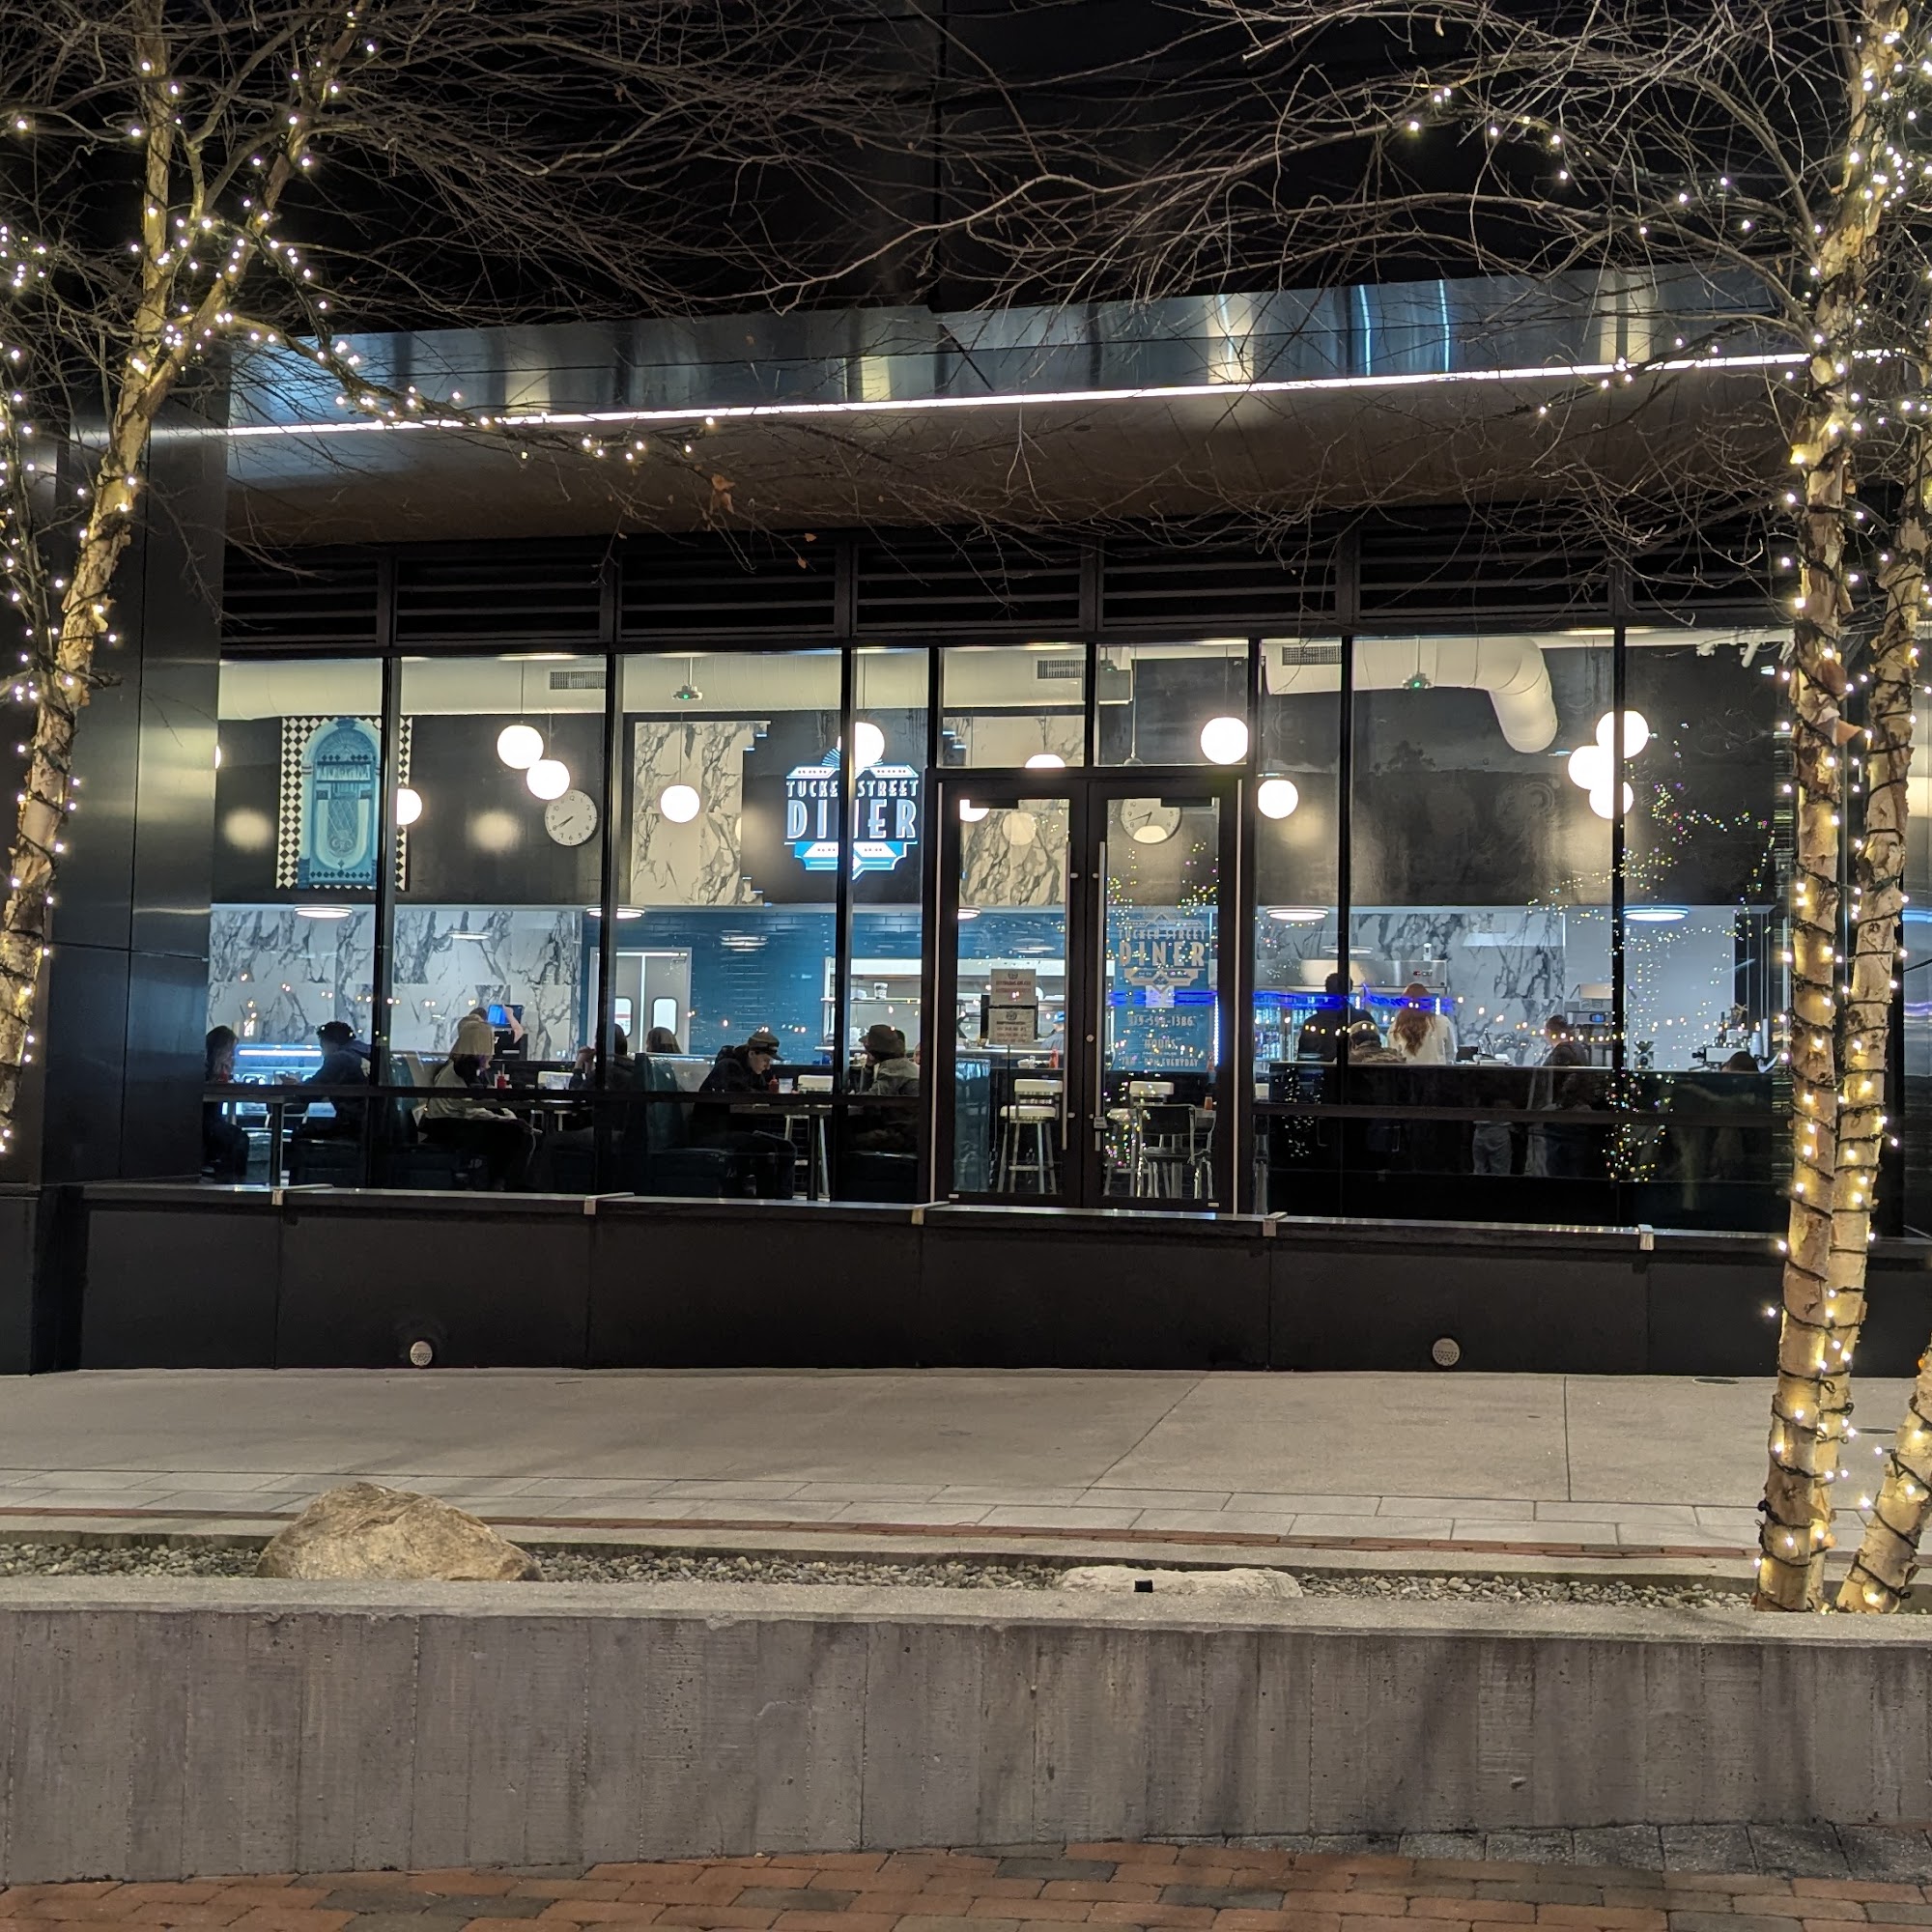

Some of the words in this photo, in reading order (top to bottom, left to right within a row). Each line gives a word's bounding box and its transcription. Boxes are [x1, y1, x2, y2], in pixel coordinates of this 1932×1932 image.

[786, 780, 838, 798] TUCKE
[857, 780, 919, 797] STREET
[1118, 929, 1160, 940] TUCKER
[1165, 929, 1207, 940] STREET
[1119, 941, 1206, 967] DINER
[1161, 1058, 1199, 1067] EVERYDAY
